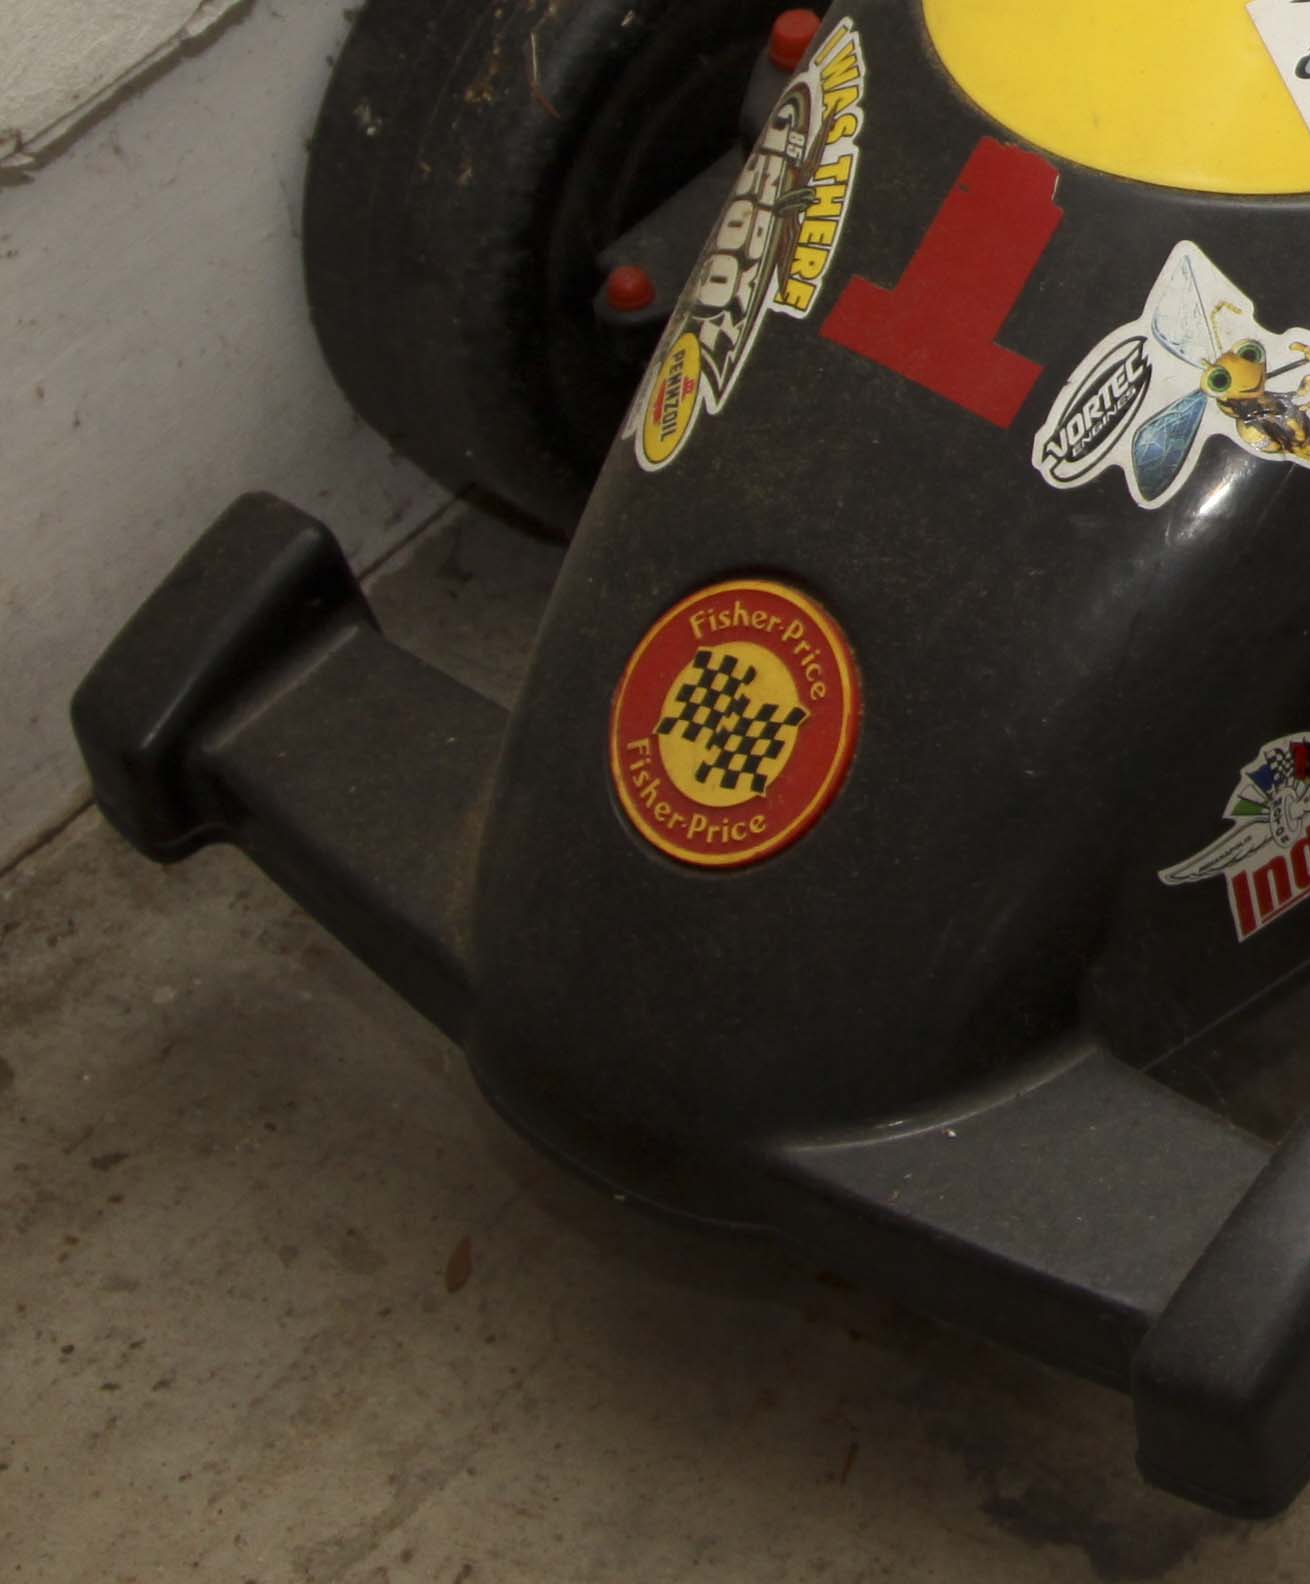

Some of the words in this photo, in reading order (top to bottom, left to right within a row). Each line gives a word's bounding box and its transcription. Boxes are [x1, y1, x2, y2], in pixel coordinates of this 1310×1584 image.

[773, 154, 854, 312] THERE
[659, 349, 686, 443] PENNZOIL
[1042, 338, 1148, 461] VORTEC
[1071, 386, 1137, 458] ENGINES
